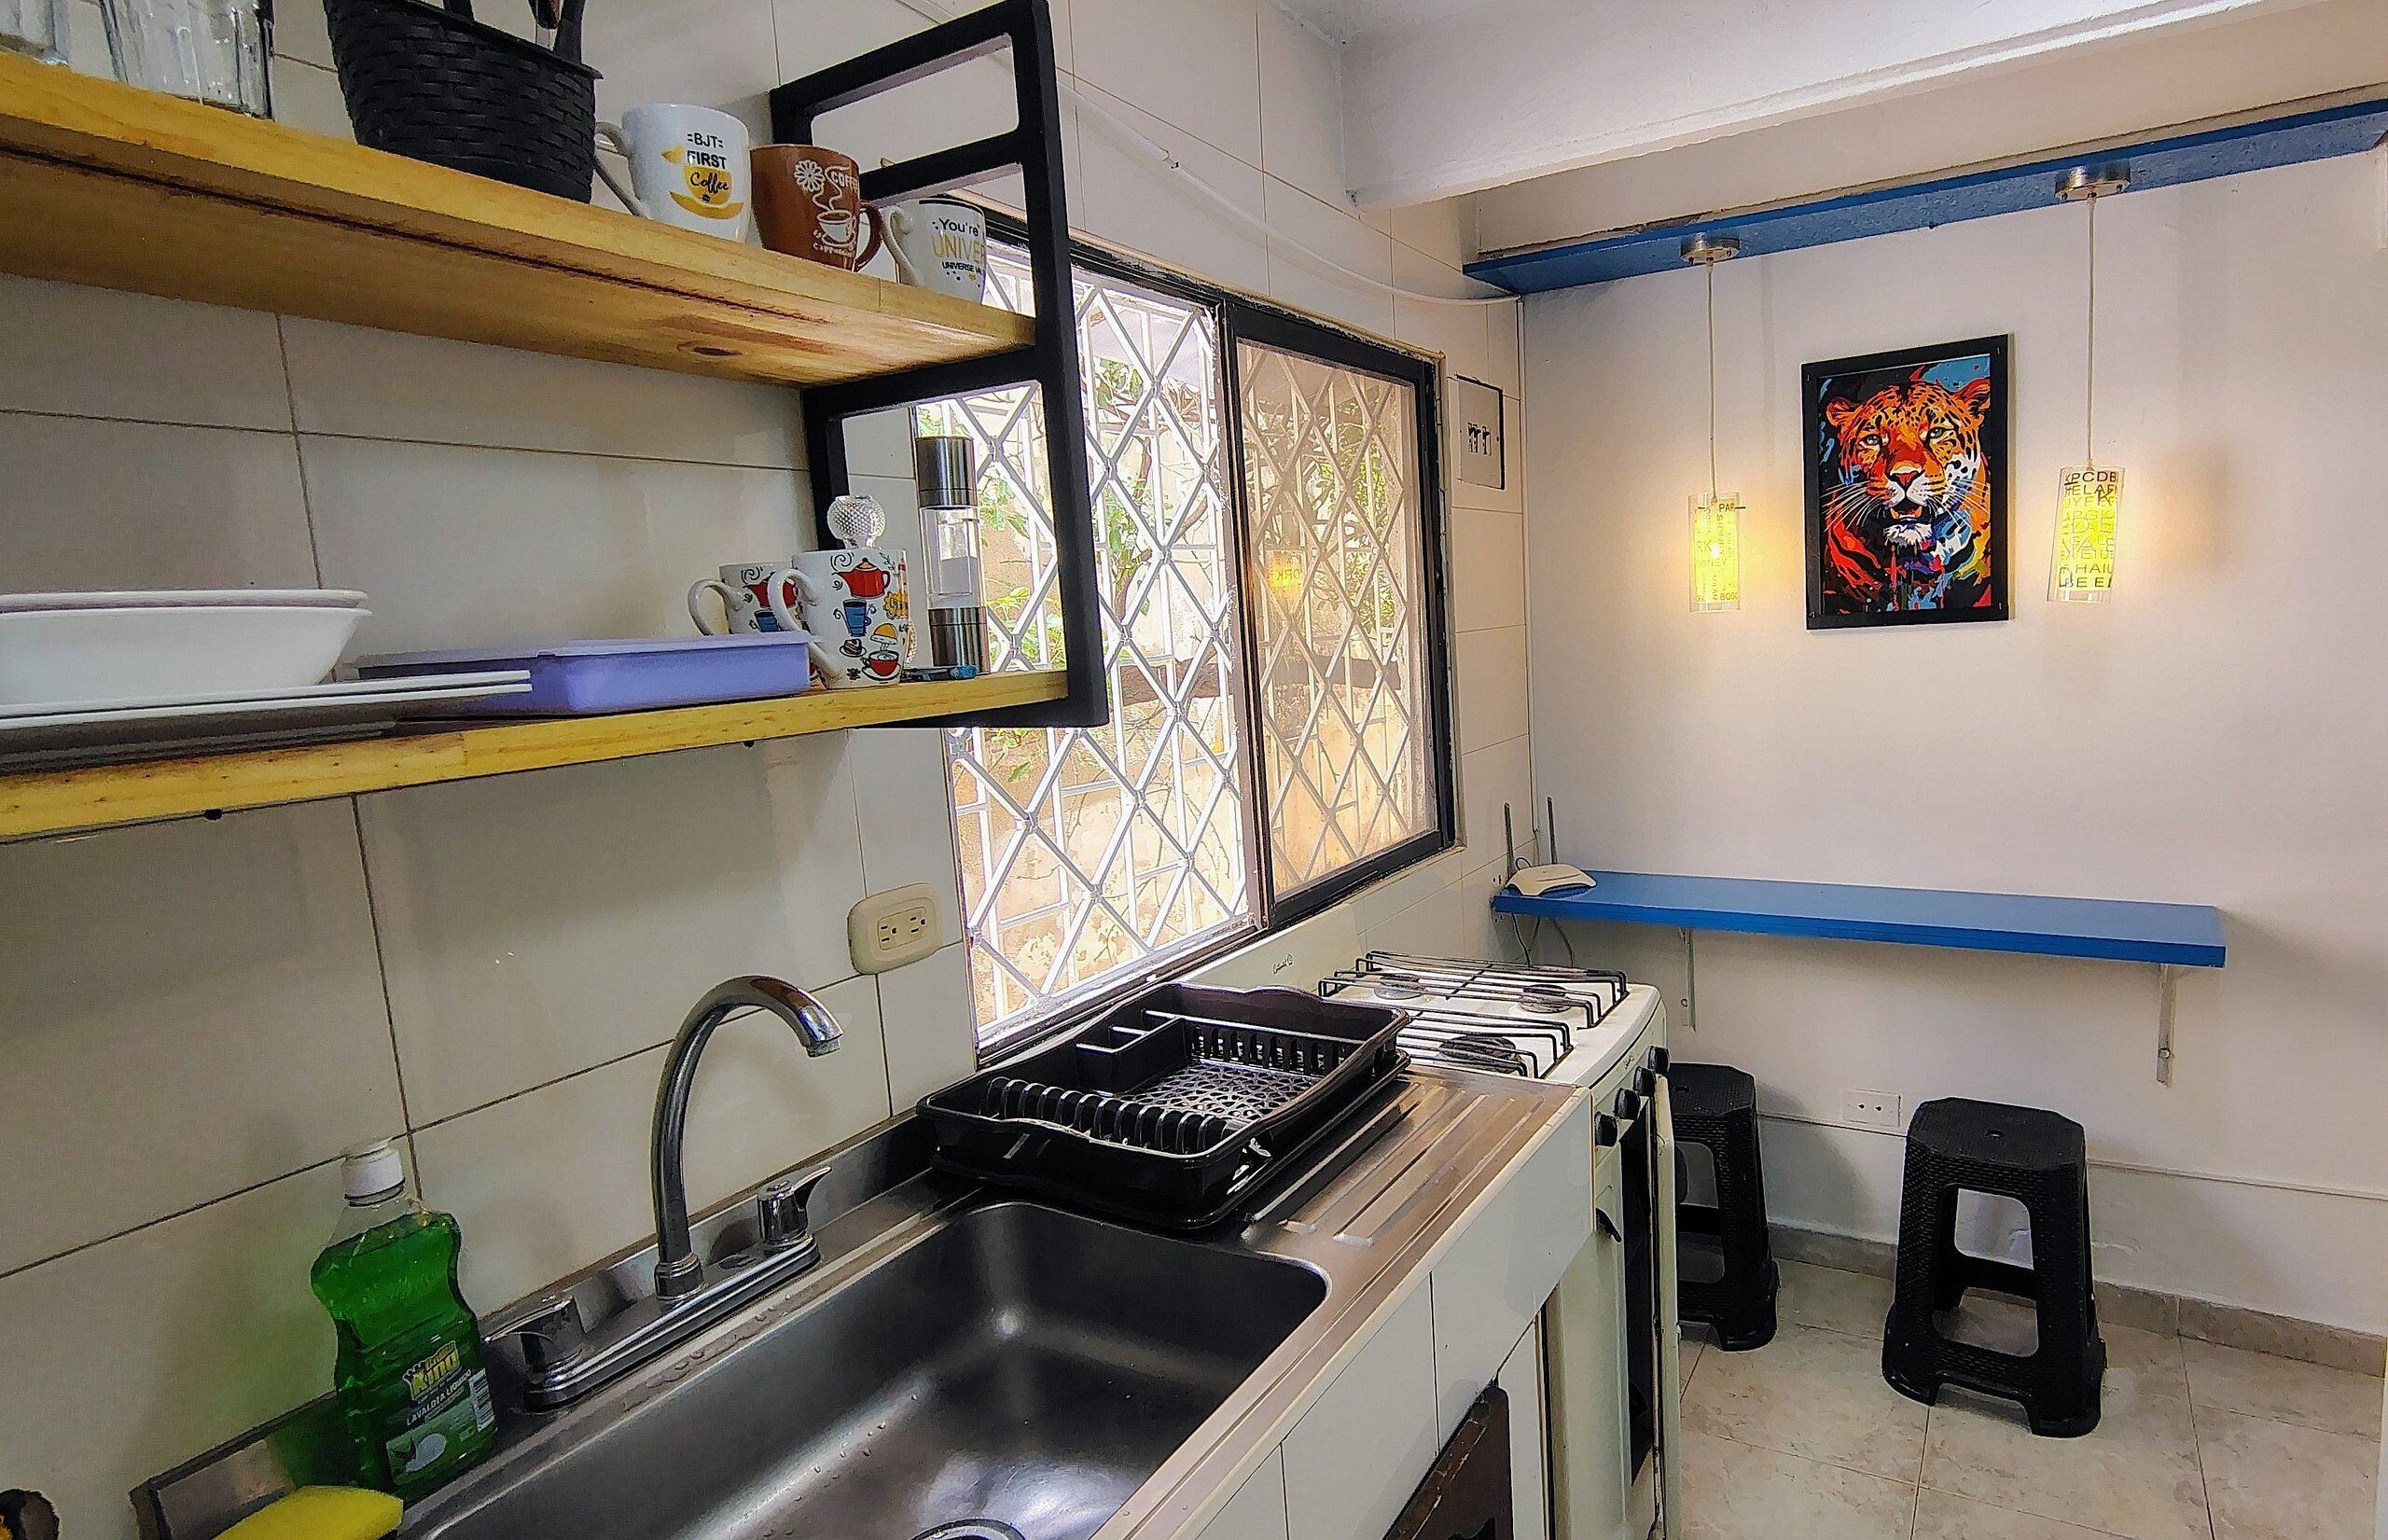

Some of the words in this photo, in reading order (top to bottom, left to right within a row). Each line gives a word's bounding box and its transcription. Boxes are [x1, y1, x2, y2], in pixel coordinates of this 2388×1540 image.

[687, 149, 727, 170] FIRST
[690, 172, 729, 195] Coffee
[938, 217, 979, 237] You're
